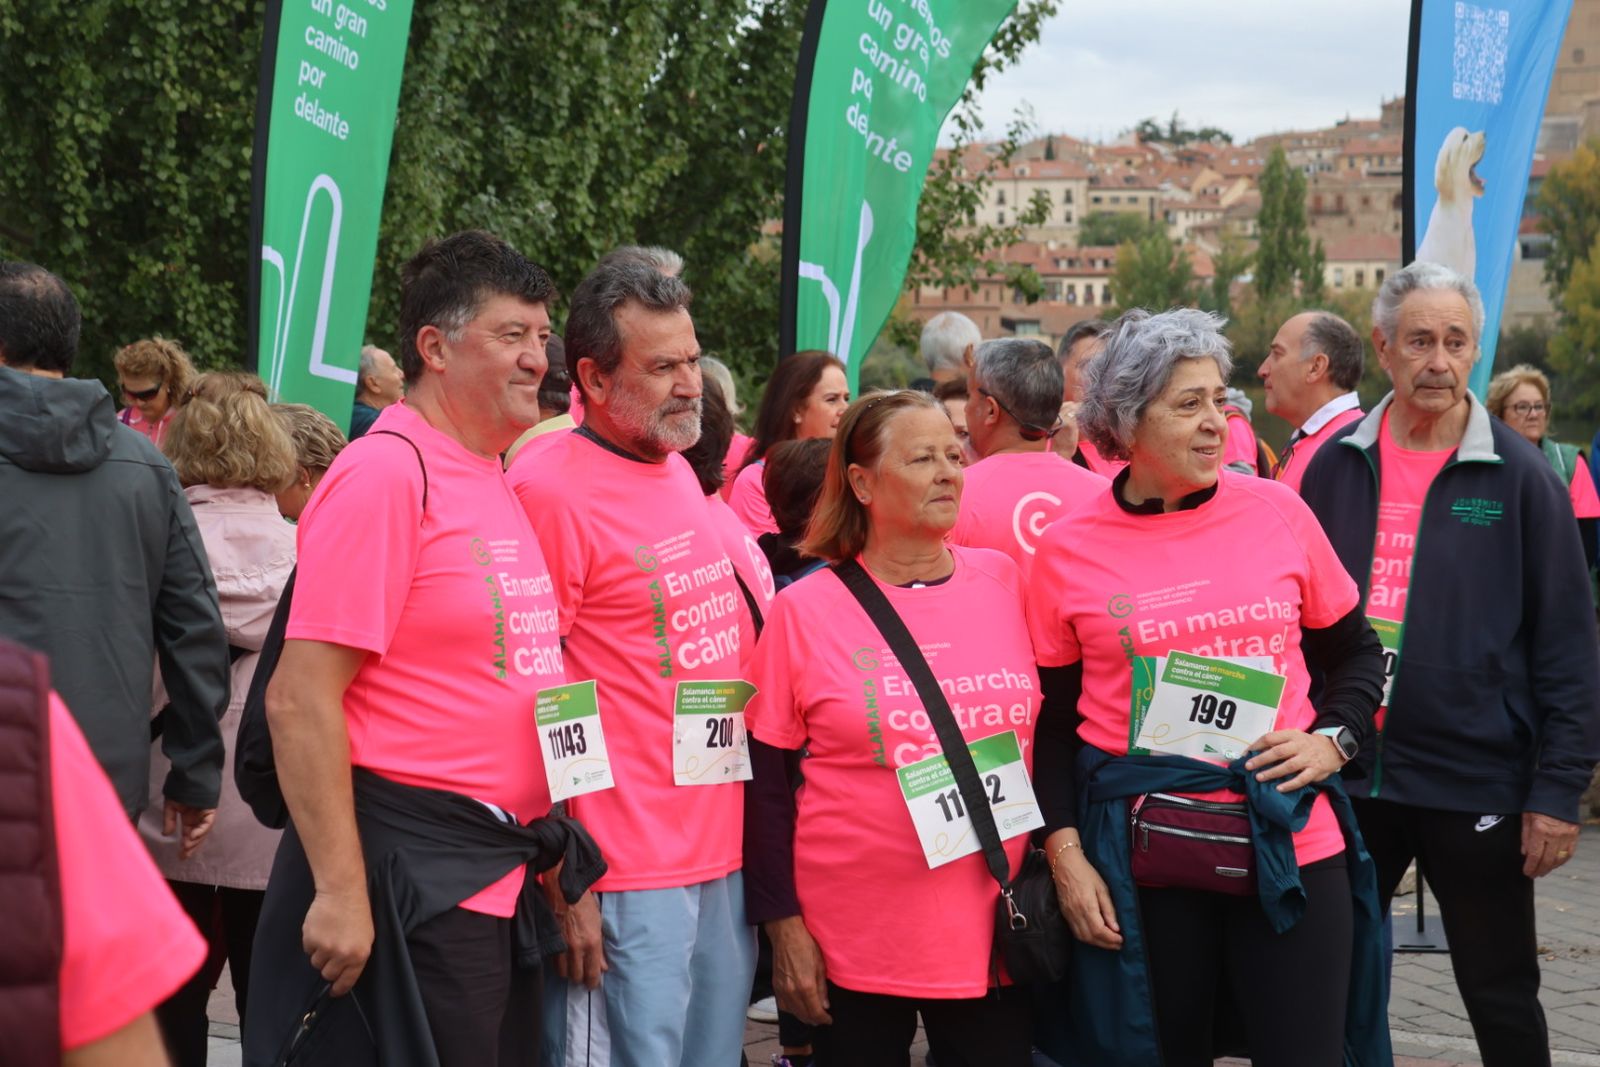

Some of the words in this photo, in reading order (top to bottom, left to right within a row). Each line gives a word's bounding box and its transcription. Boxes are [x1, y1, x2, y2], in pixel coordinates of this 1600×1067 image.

[334, 4, 367, 38] gran
[867, 0, 893, 31] un
[893, 22, 929, 73] gra
[305, 25, 359, 70] camino
[298, 59, 326, 89] por
[859, 32, 927, 103] camino
[294, 92, 349, 140] delante
[498, 572, 523, 597] En
[664, 571, 692, 598] En
[484, 575, 506, 679] SALAMANCA
[648, 579, 673, 678] SALAMANCA
[1137, 616, 1179, 645] En
[1185, 596, 1292, 634] marcha
[1268, 625, 1288, 653] el
[514, 637, 564, 677] cánc
[677, 622, 741, 670] cánc
[1173, 658, 1210, 672] Salamanca
[1171, 667, 1194, 676] contra
[1194, 670, 1201, 678] el
[1008, 697, 1032, 725] el
[1188, 694, 1237, 730] 199
[548, 722, 587, 760] 11143
[705, 717, 734, 748] 200
[935, 774, 1006, 823] 112
